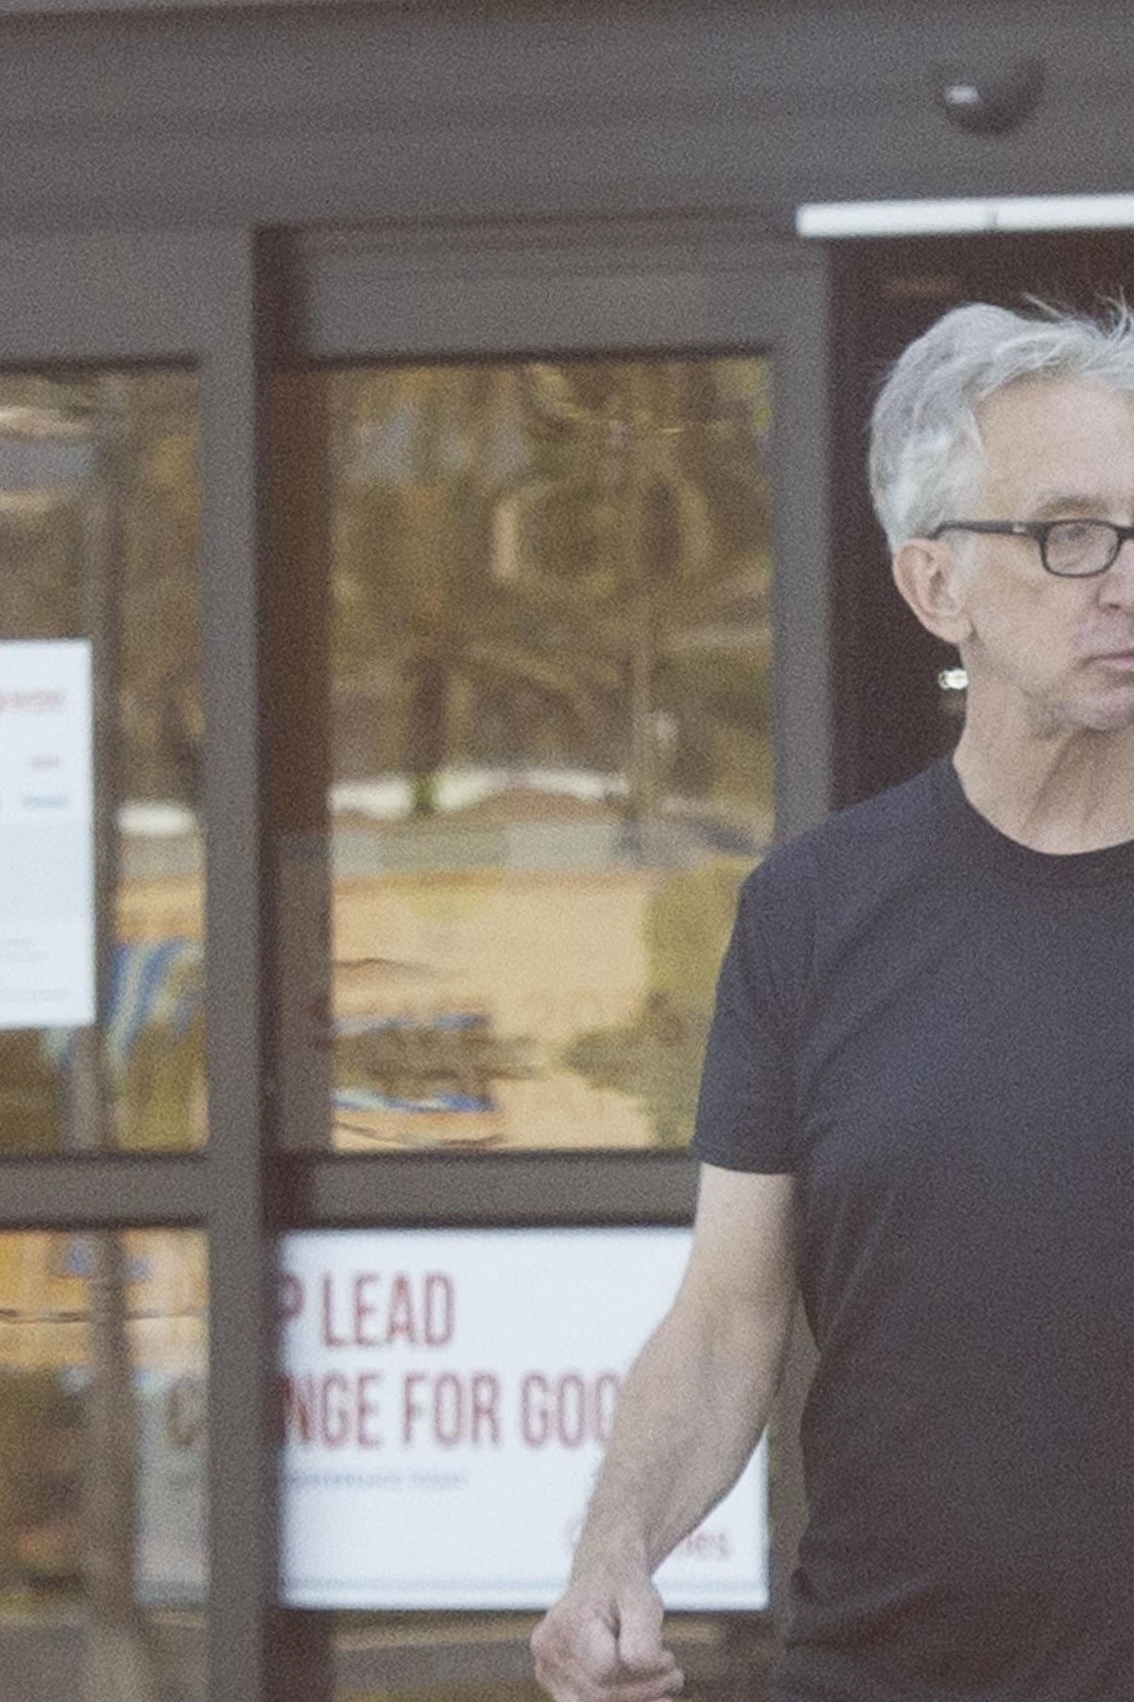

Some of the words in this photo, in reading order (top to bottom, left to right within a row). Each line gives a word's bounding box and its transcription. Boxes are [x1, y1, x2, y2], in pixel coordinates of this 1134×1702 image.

[321, 1272, 455, 1347] LEAD
[400, 1371, 500, 1448] FOR
[519, 1371, 627, 1449] GOO
